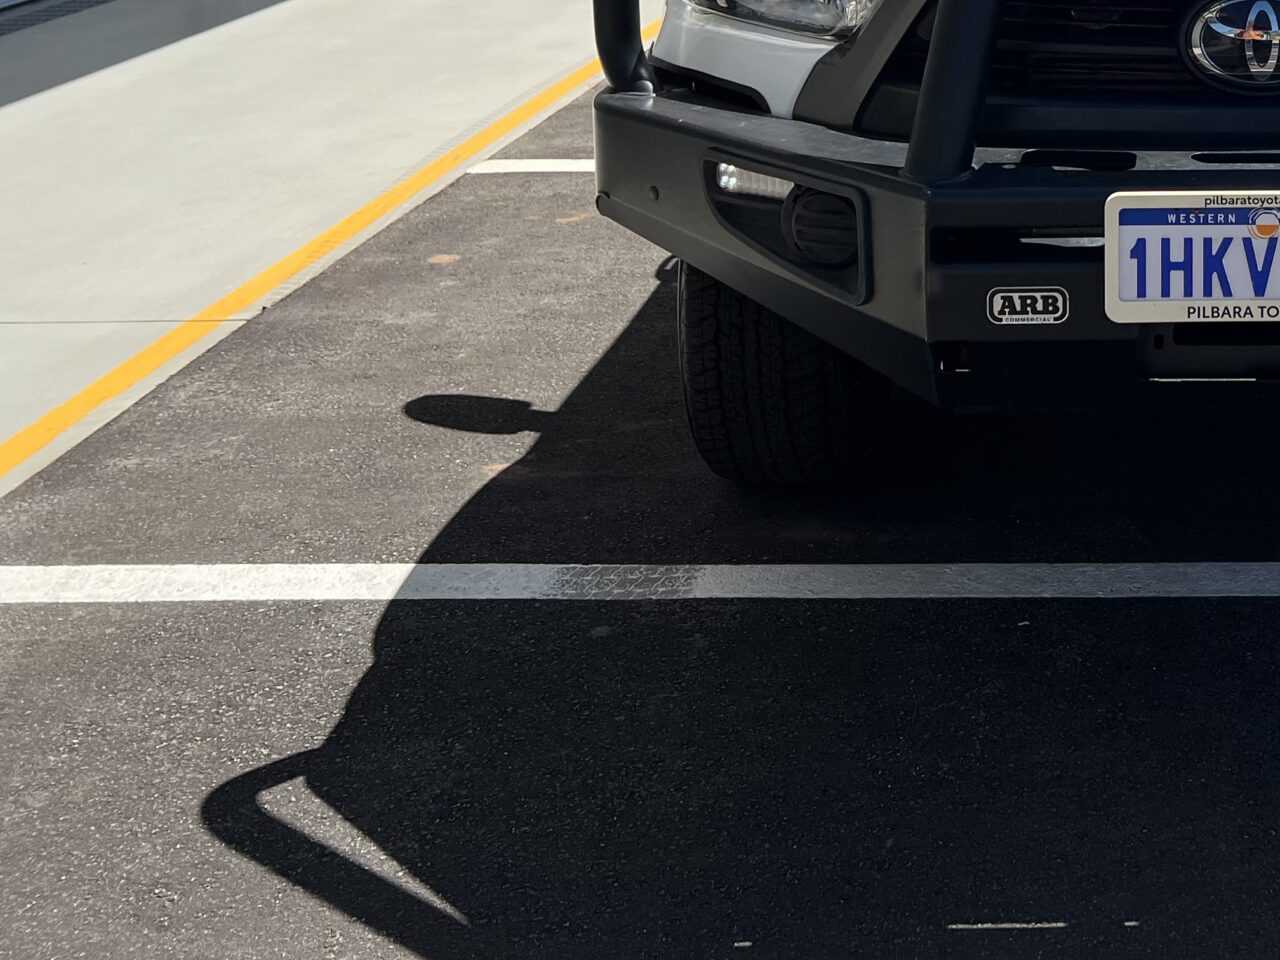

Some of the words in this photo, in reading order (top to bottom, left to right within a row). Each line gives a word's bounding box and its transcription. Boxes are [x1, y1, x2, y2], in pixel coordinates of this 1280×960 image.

[1167, 213, 1236, 224] WESTERN
[998, 294, 1060, 315] ARB
[1187, 306, 1253, 319] PILBARA
